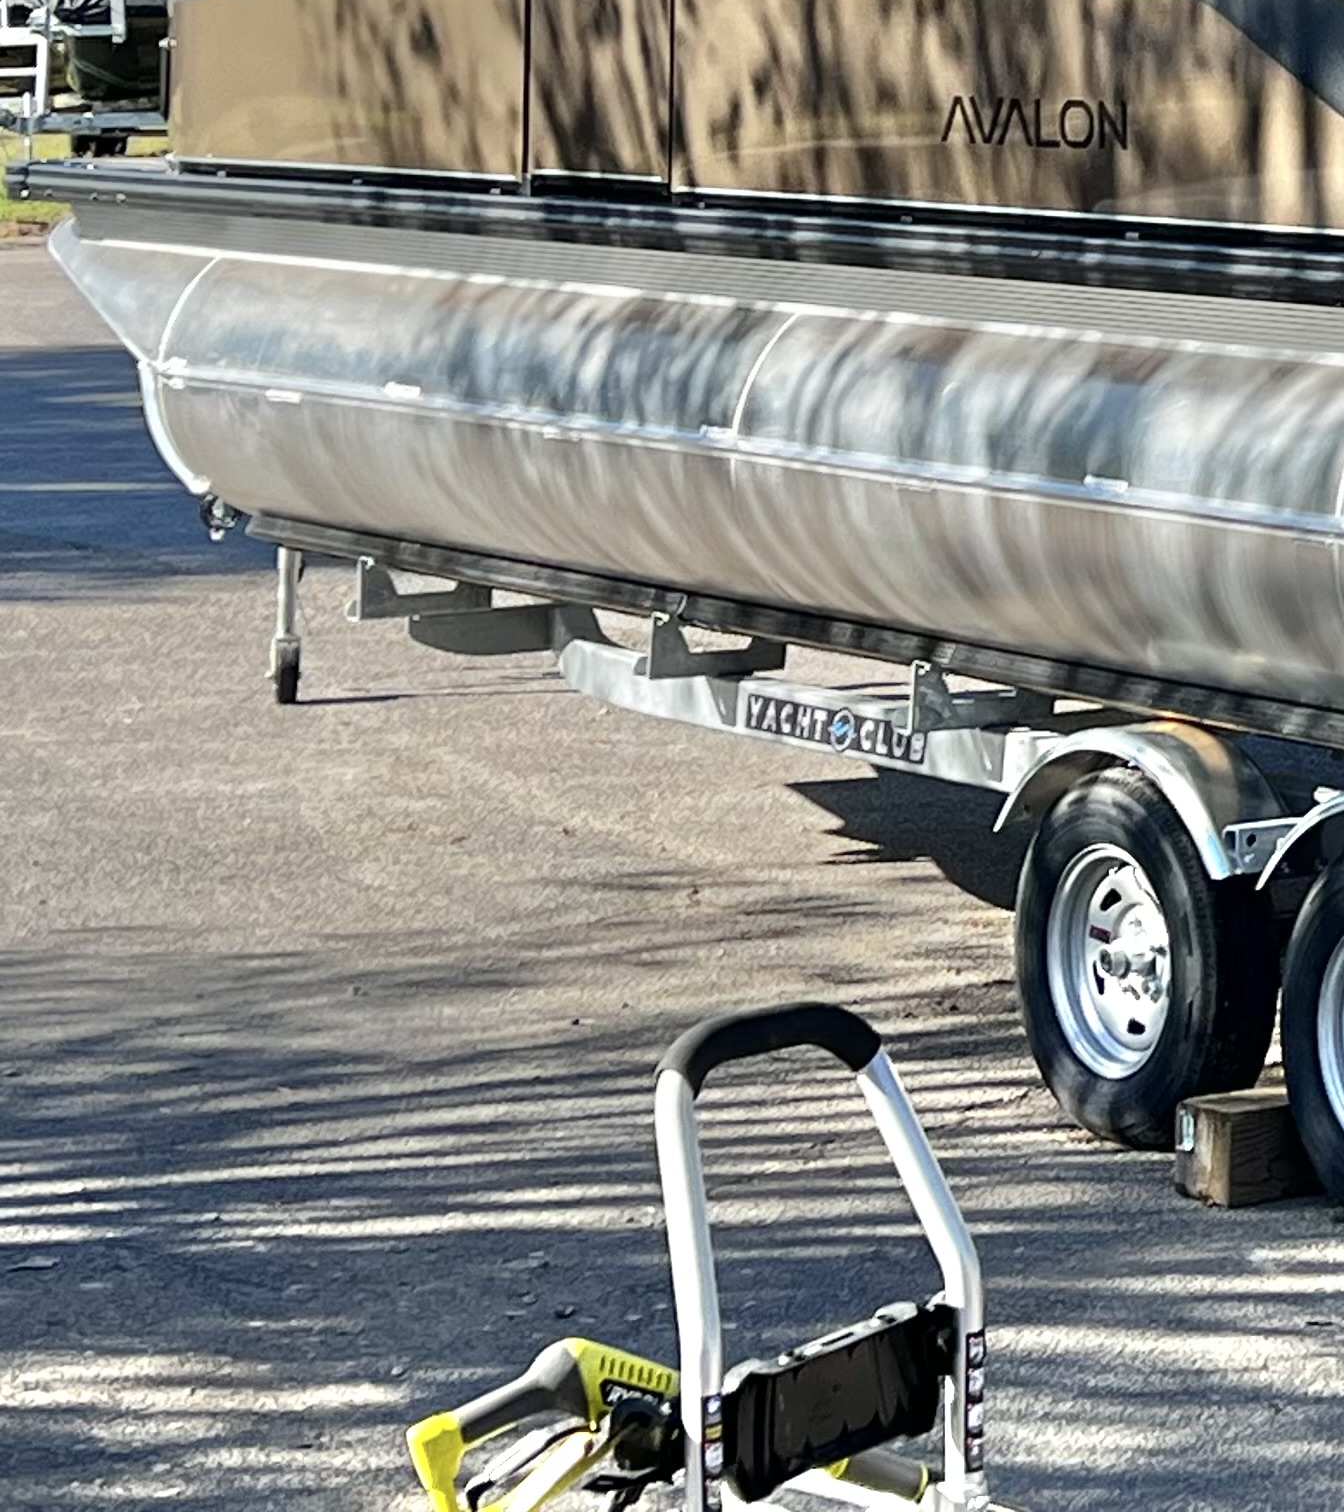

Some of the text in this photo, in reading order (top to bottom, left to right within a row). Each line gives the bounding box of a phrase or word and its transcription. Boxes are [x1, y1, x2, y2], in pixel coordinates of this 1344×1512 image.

[941, 96, 1128, 150] AVALON
[749, 696, 924, 762] YACHT CLUB
